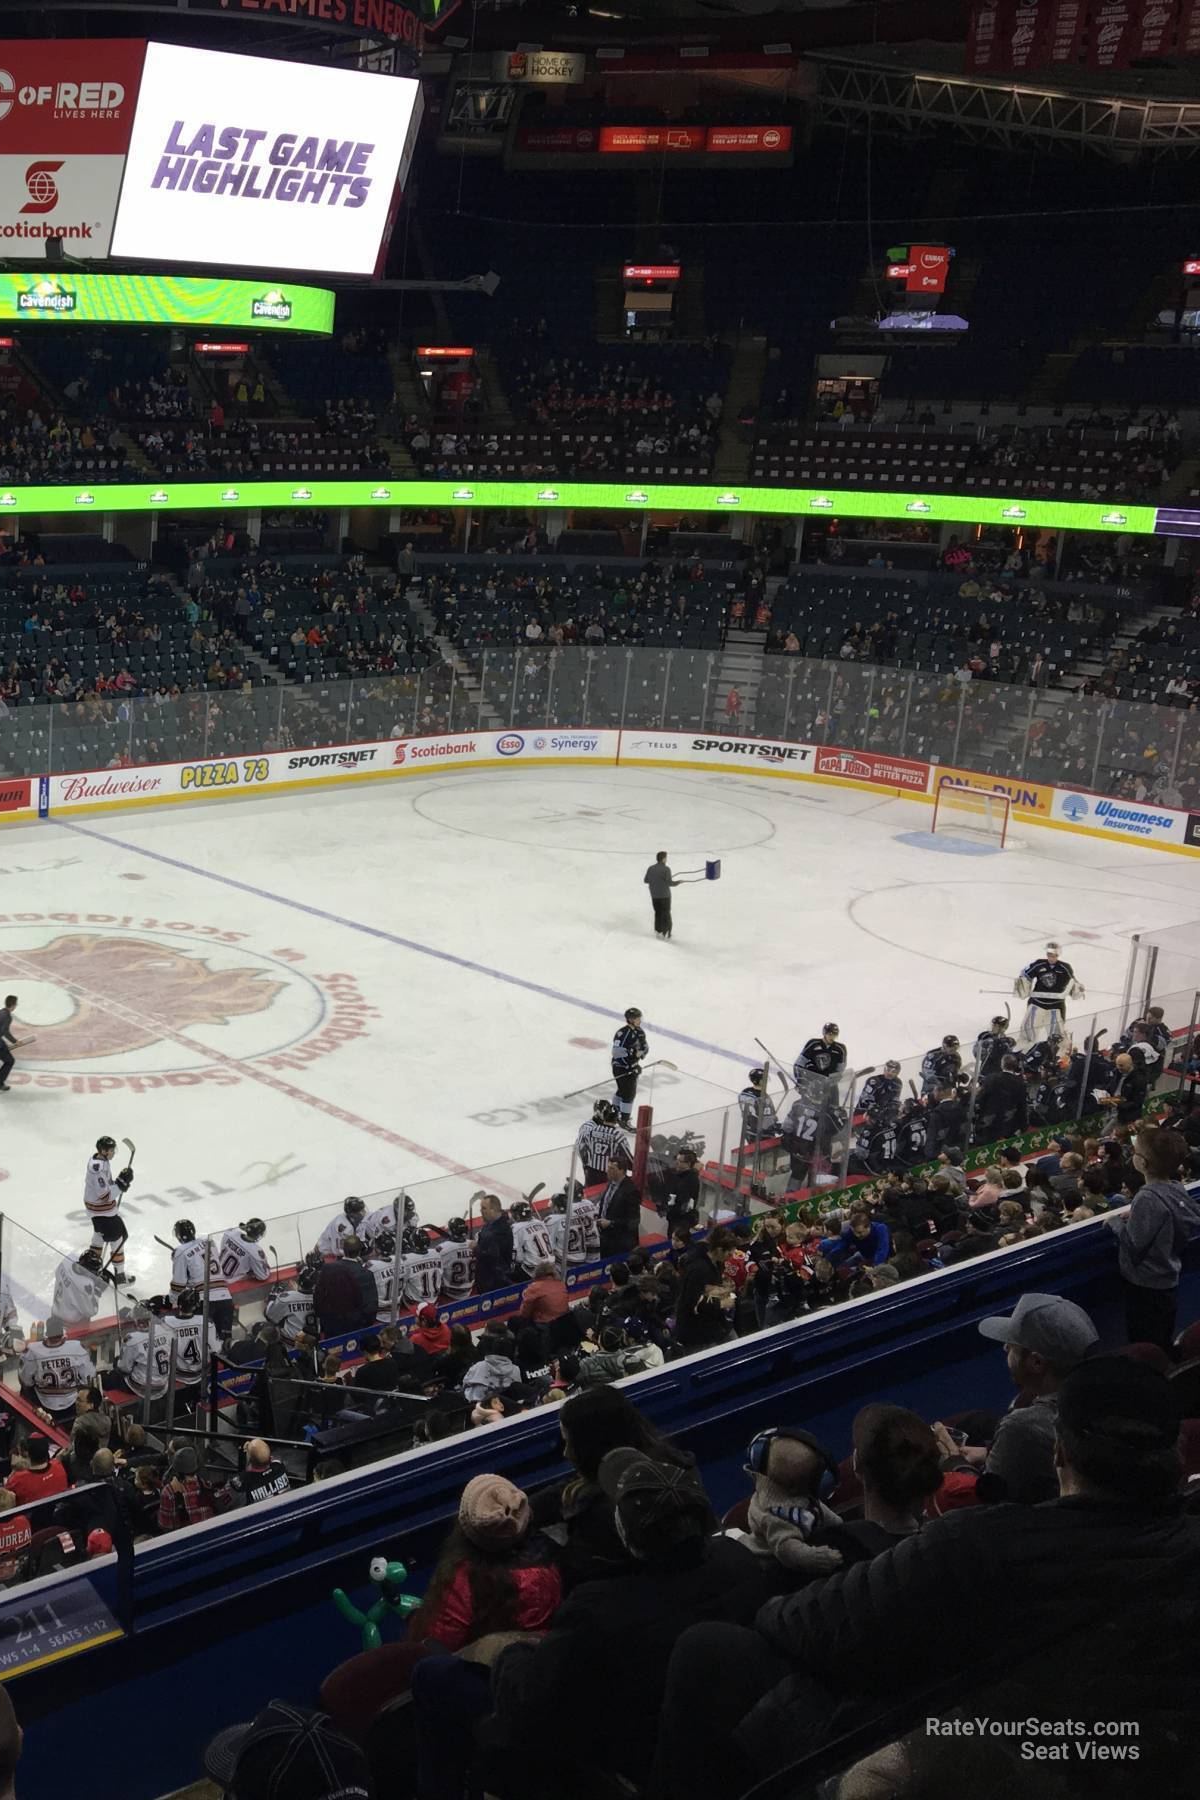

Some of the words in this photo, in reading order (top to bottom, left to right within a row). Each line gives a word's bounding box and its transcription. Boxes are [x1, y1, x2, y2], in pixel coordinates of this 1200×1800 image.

[532, 57, 557, 67] HOME
[559, 57, 572, 66] OF
[531, 66, 574, 77] HOCKEY
[18, 86, 52, 106] OF
[55, 82, 125, 109] RED
[53, 110, 86, 119] LIVES
[90, 110, 120, 119] HERE
[163, 121, 267, 162] LAST
[269, 133, 375, 175] GAME
[151, 156, 372, 209] HIGHLIGHTS
[20, 293, 74, 309] Cavendish
[253, 302, 291, 317] Cavendish
[411, 741, 476, 759] Scotiabank
[501, 736, 520, 750] Esso
[551, 738, 598, 751] Synergy
[648, 742, 678, 750] TELUS
[692, 740, 811, 762] SPORTSNET
[288, 749, 377, 770] SPORTSNET
[820, 758, 841, 772] PAPA
[181, 762, 238, 789] PIZZA
[244, 758, 269, 782] 73
[873, 770, 901, 781] BETTER
[60, 775, 161, 801] Budweiser
[1094, 800, 1174, 829] Wawanesa
[796, 1116, 818, 1142] 12
[595, 1143, 609, 1155] 87
[41, 1357, 71, 1370] PETERS
[155, 1350, 169, 1376] 6
[5, 1602, 66, 1644] 211
[20, 1643, 42, 1659] 1-4
[49, 1628, 82, 1648] SEATS
[82, 1619, 109, 1637] 1-12
